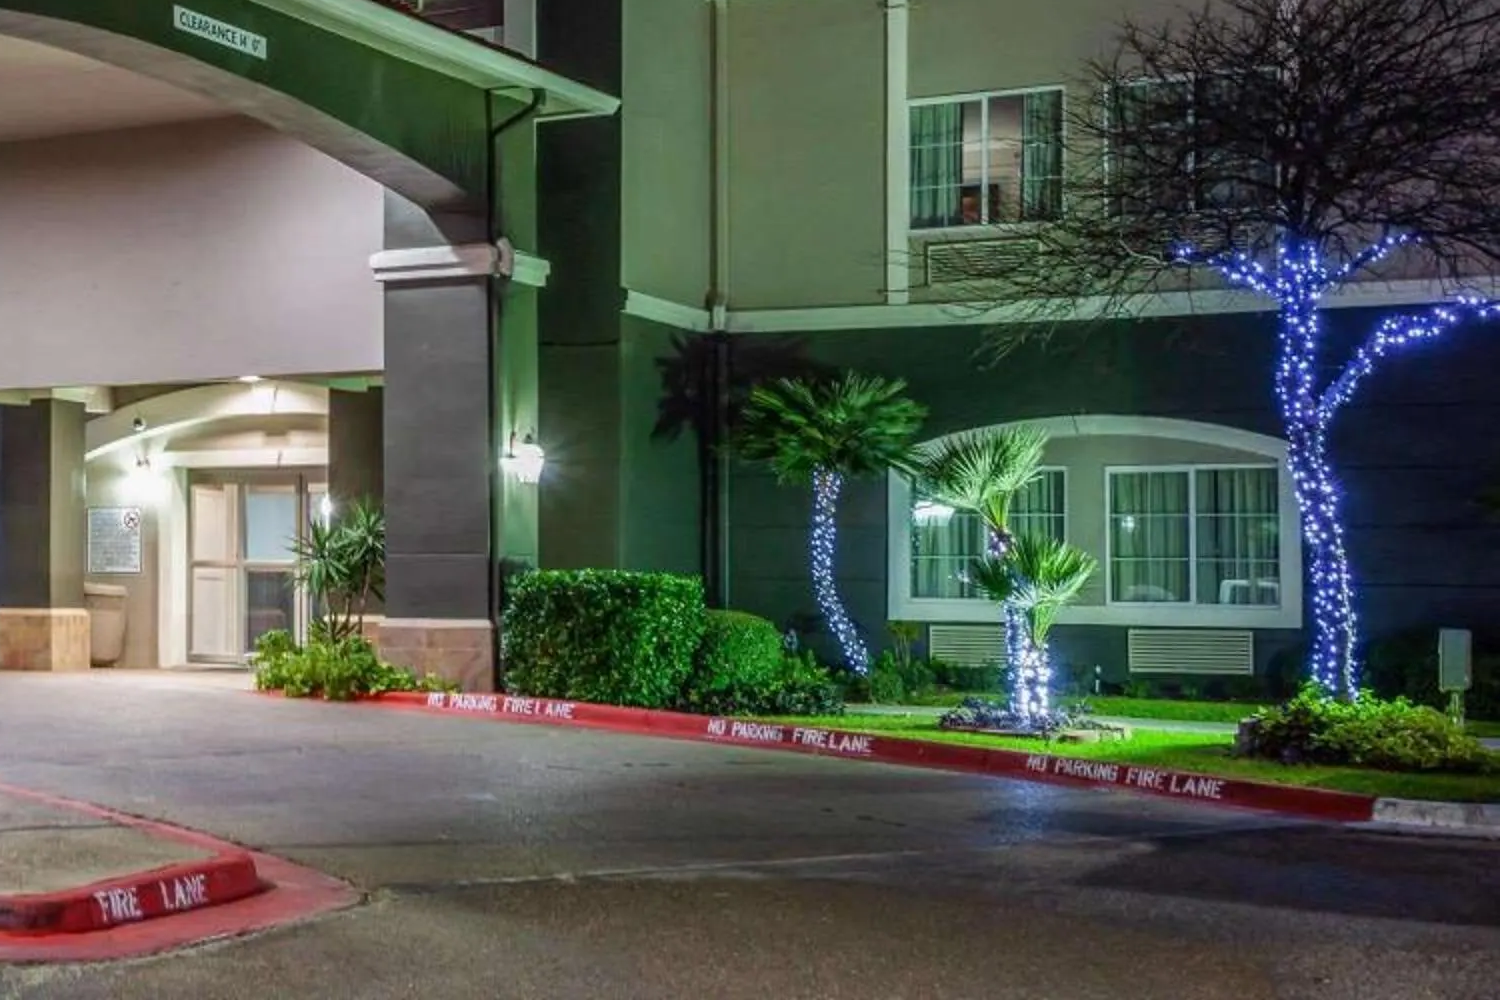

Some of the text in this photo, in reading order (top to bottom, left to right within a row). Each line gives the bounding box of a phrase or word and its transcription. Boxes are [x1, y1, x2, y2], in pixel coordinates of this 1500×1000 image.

[179, 10, 238, 47] CLEARANCE
[503, 696, 533, 715] FIRE
[534, 702, 576, 719] LANE
[707, 718, 874, 755] NO PARKING FIRE LANE
[1026, 754, 1226, 799] NO PARKING FIRE LANE
[93, 873, 208, 922] FIRE LANE
